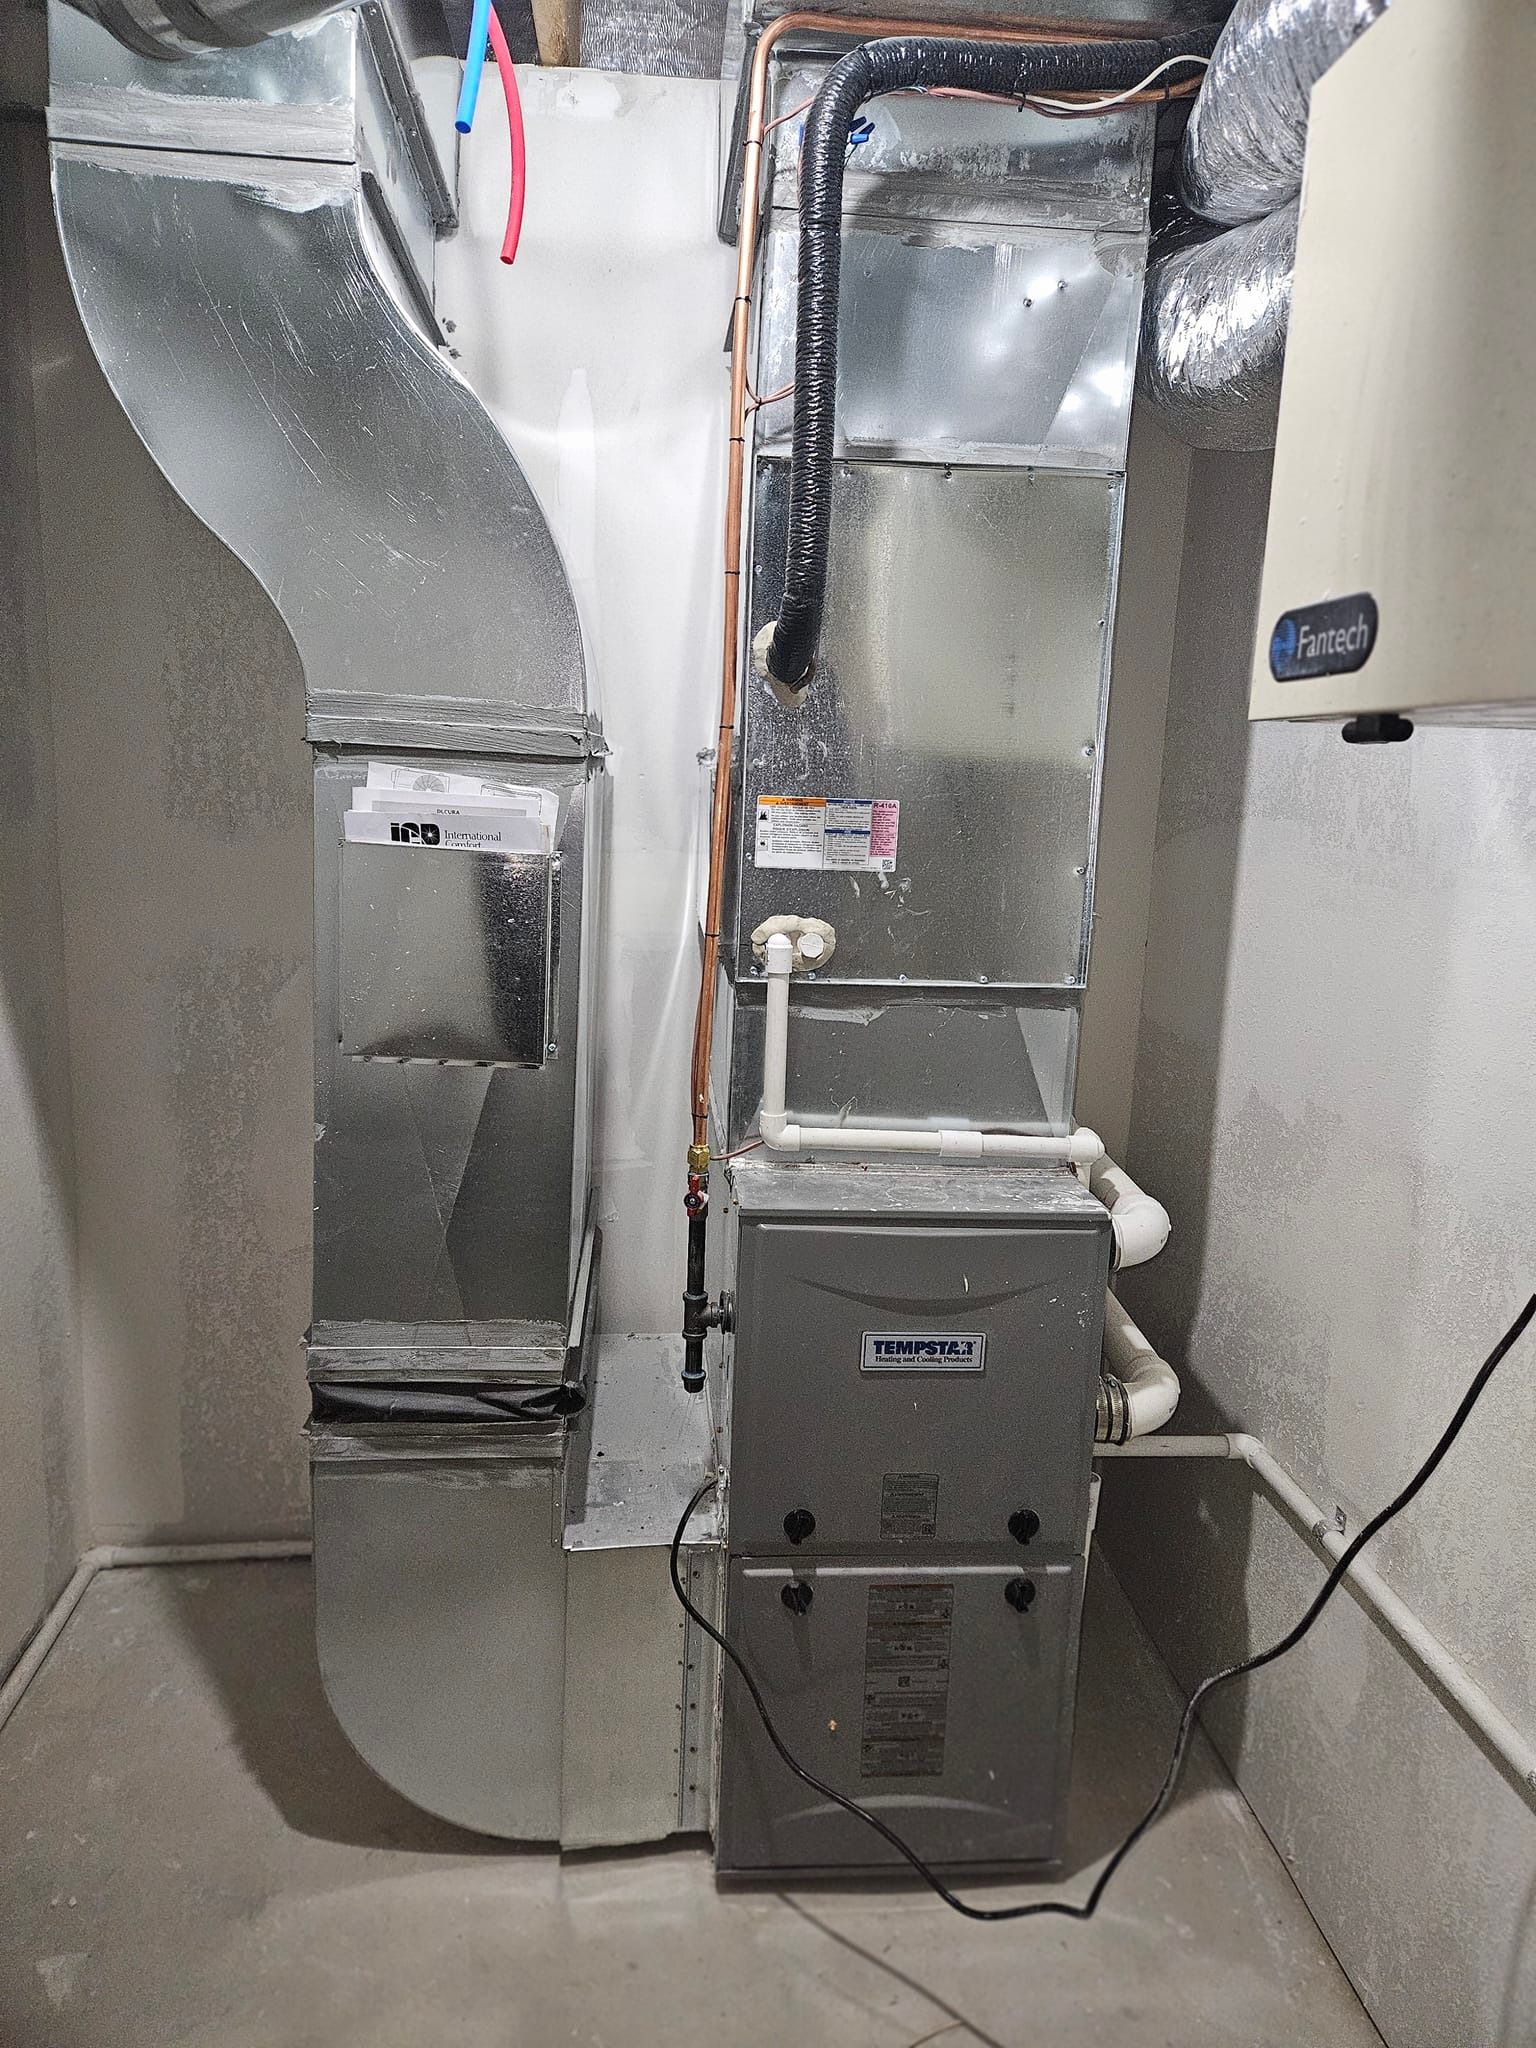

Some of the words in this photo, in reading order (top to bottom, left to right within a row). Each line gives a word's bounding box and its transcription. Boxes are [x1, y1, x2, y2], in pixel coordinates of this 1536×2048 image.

[1297, 614, 1368, 659] Fantech
[444, 830, 502, 842] International
[873, 1340, 973, 1356] TEMPSTAR
[916, 1356, 942, 1364] Cooling
